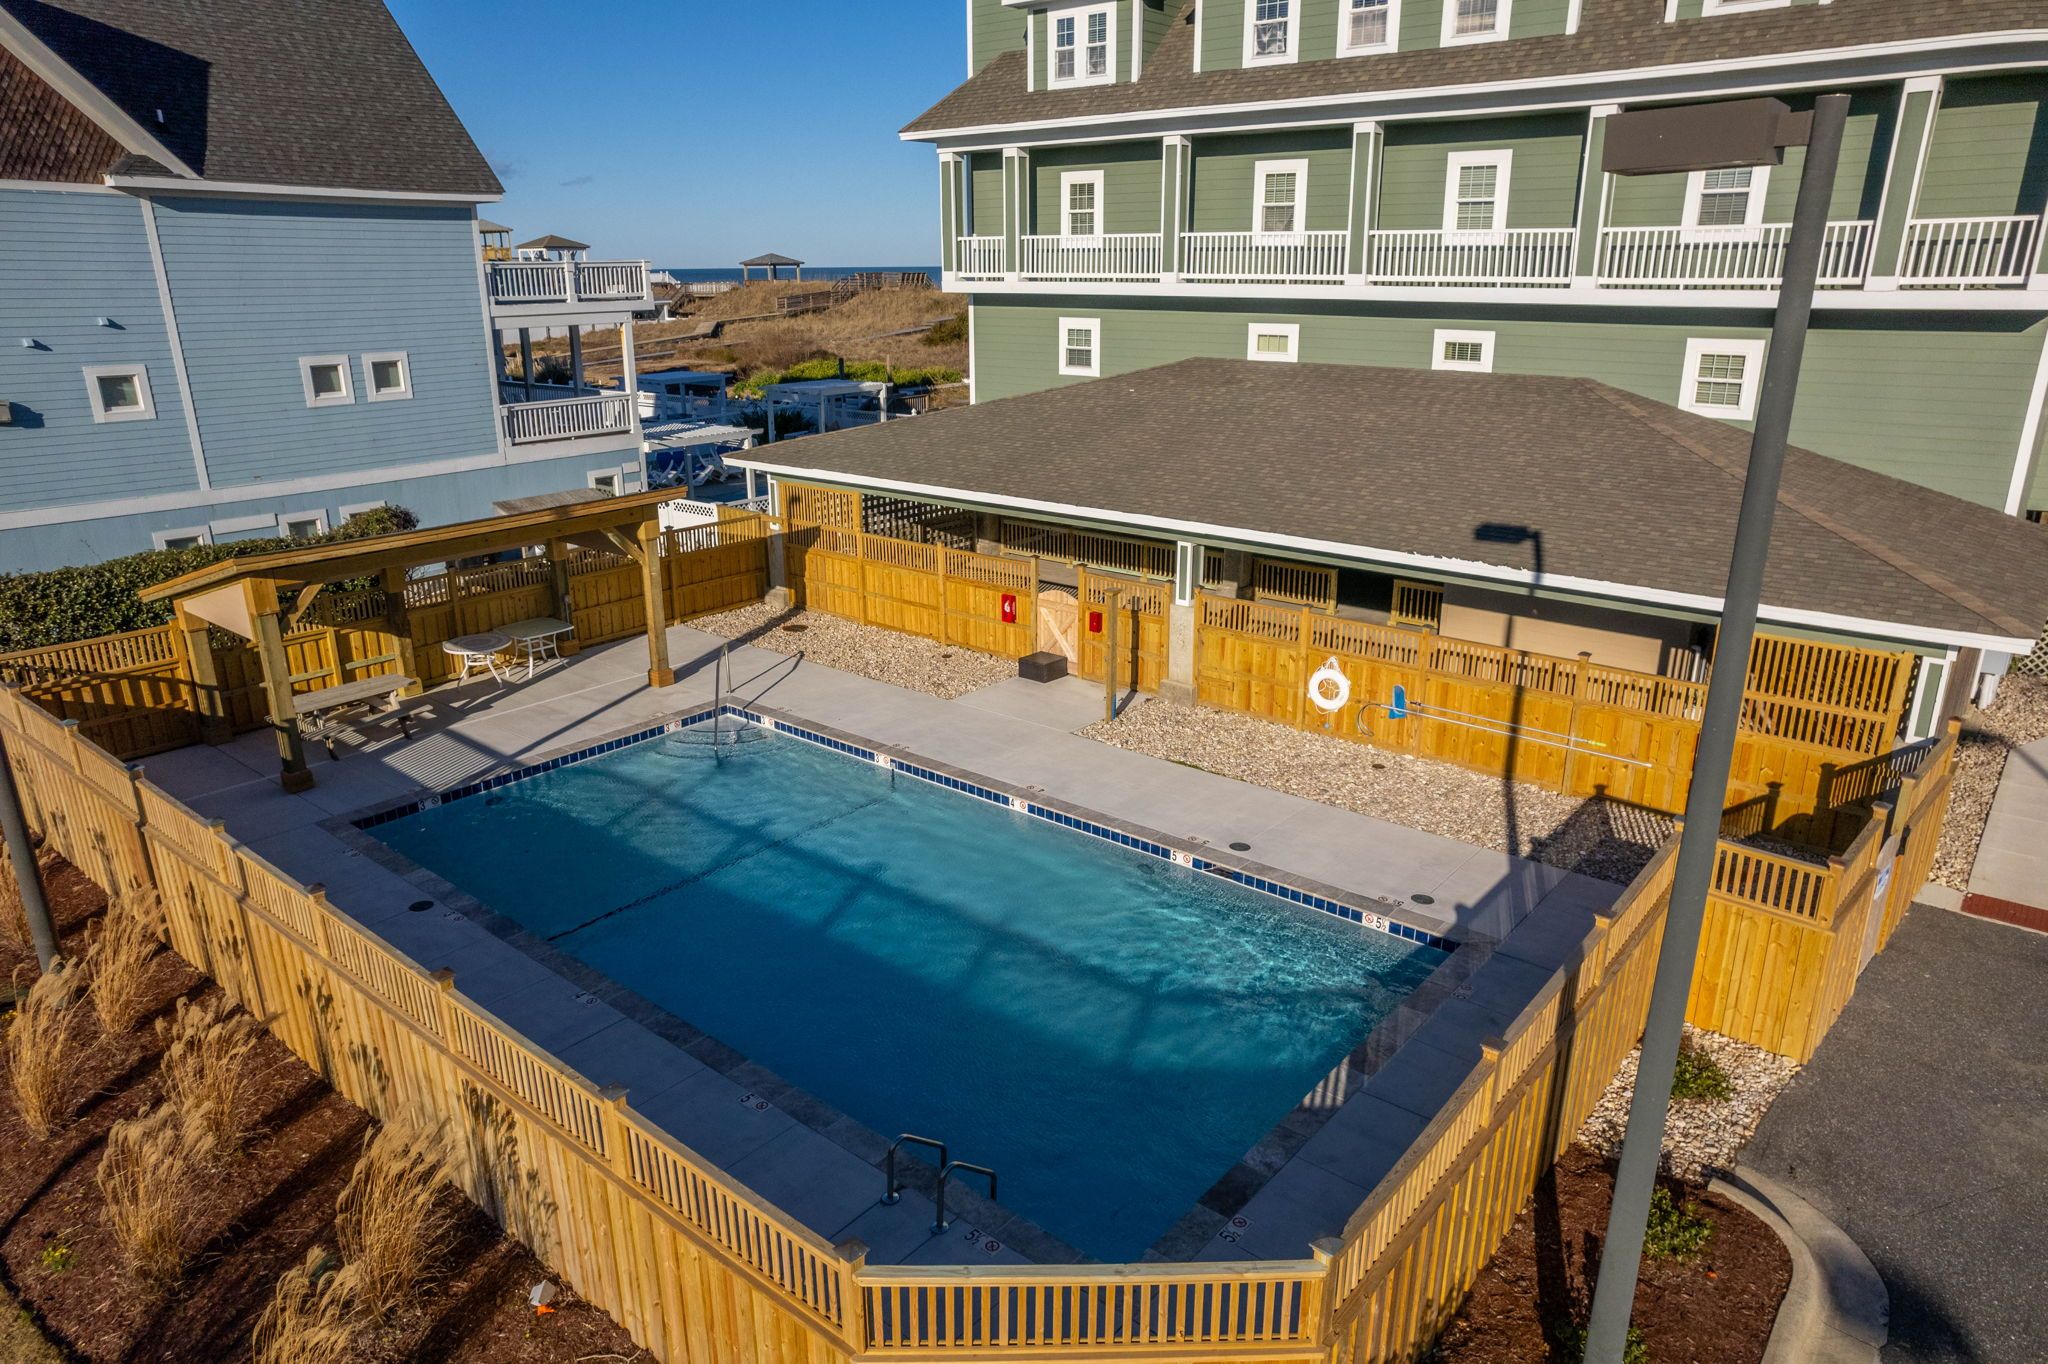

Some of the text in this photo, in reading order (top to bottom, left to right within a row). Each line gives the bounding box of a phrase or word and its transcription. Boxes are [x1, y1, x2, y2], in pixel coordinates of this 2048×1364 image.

[665, 723, 670, 732] 3
[875, 753, 880, 763] 3
[419, 800, 426, 811] 3
[1010, 798, 1015, 808] 4
[1171, 850, 1177, 861] 5
